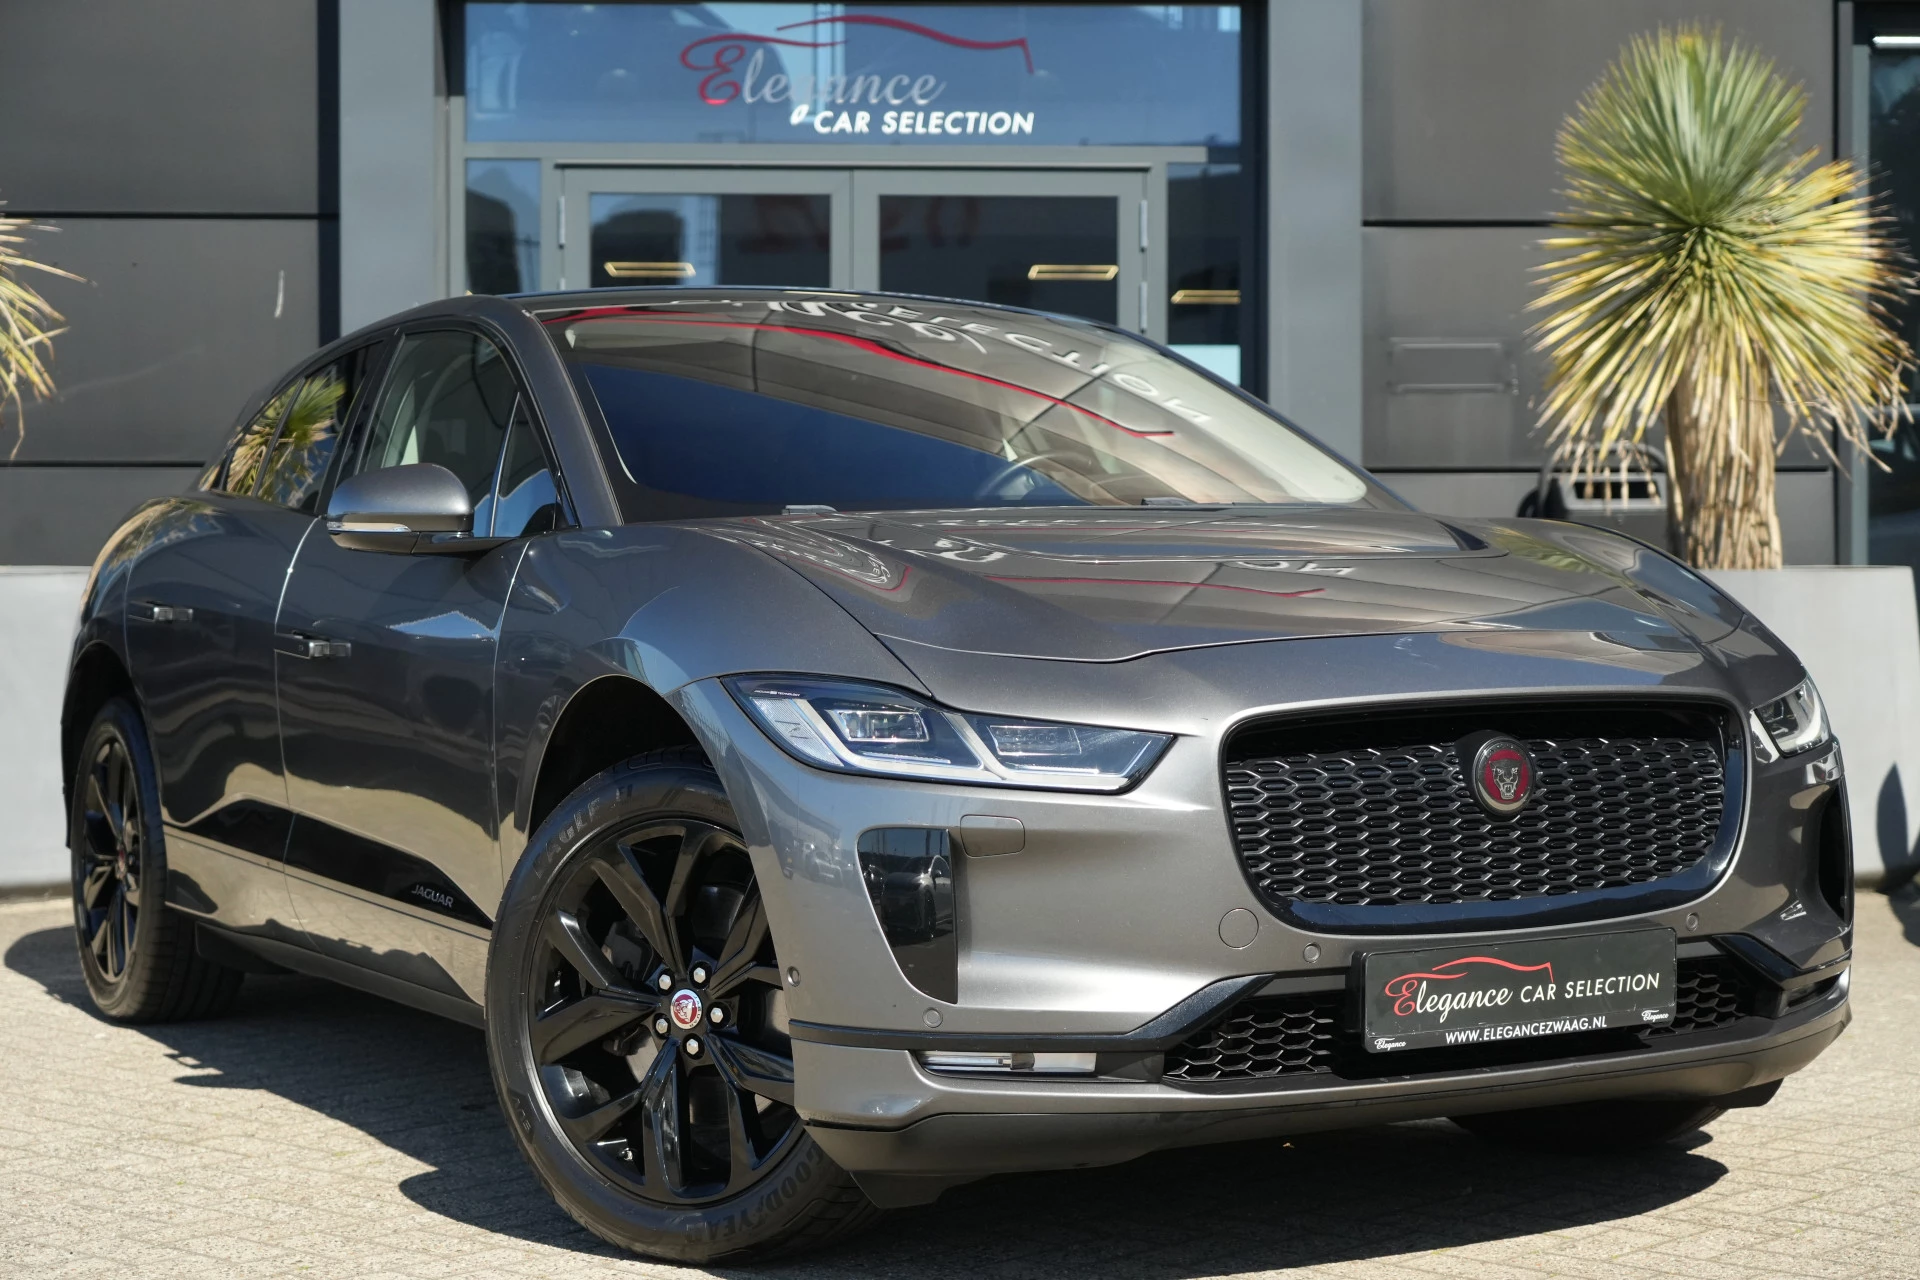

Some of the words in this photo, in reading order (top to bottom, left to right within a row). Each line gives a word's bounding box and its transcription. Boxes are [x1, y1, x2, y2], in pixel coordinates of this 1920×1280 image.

[813, 110, 871, 134] CAR
[881, 111, 1035, 135] SELECTION
[411, 884, 454, 908] JAGUAR
[1384, 972, 1514, 1024] Elegance
[1520, 982, 1557, 1003] CAR
[1564, 972, 1660, 999] SELECTION
[1640, 1009, 1669, 1022] Elegance
[1445, 1016, 1608, 1045] WWW.ELEGANCEZWAAG.NL
[1374, 1037, 1407, 1051] Elegance
